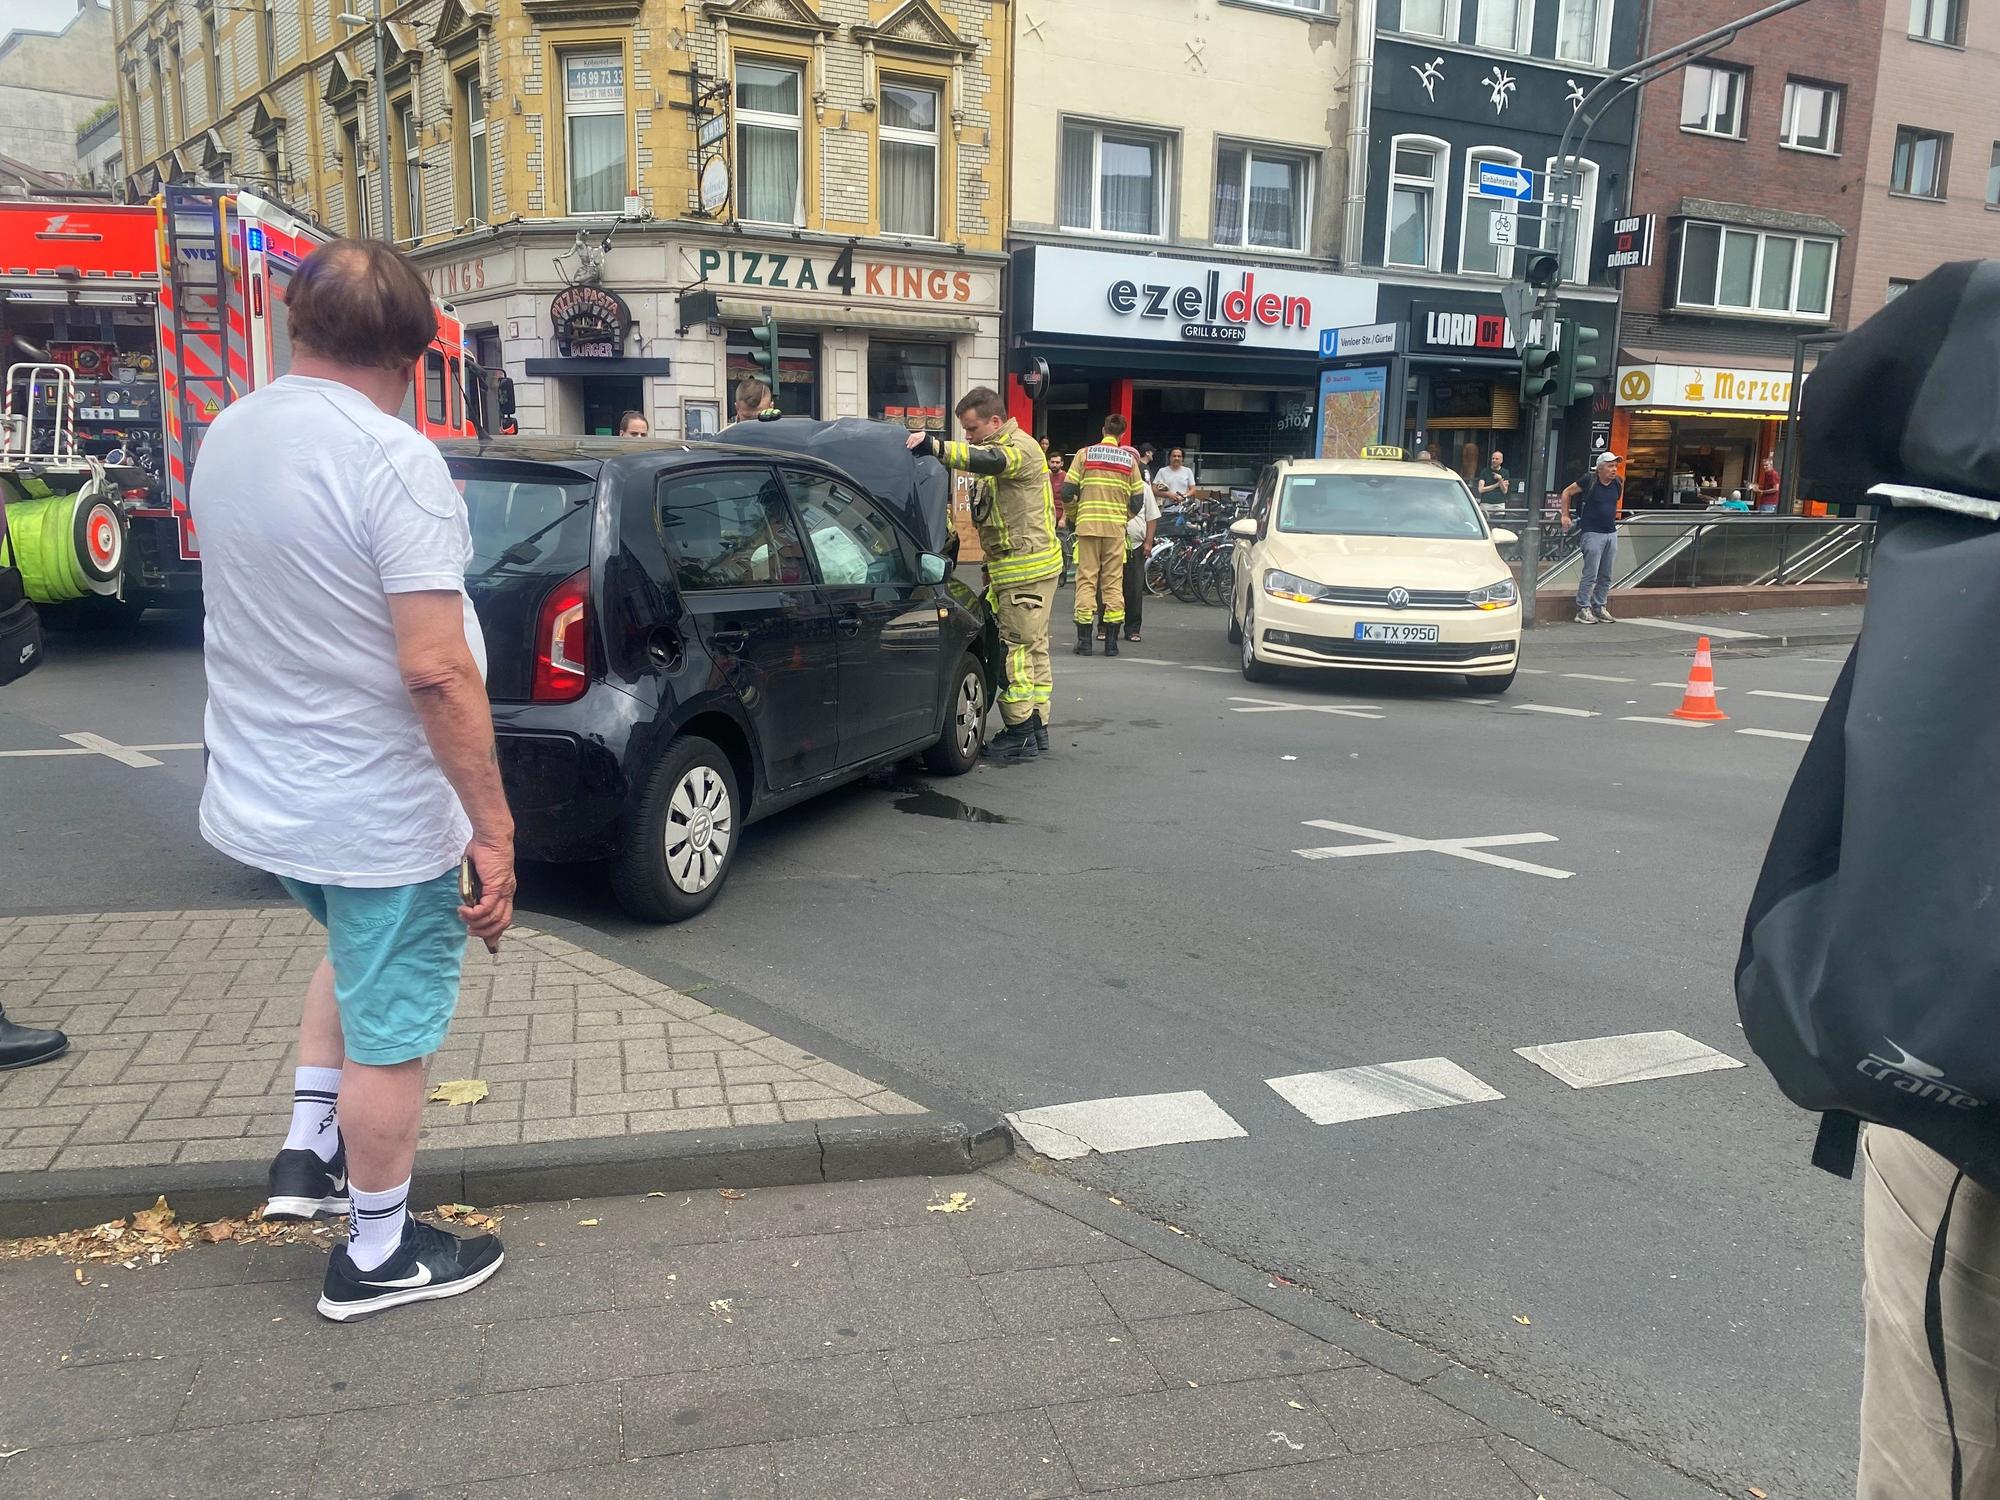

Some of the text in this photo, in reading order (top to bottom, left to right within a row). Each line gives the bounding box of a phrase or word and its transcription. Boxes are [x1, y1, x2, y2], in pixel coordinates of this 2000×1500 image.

[577, 70, 623, 86] 16 99 73 33
[1614, 217, 1640, 234] LORD
[1607, 250, 1640, 268] DÖNER
[700, 246, 971, 301] PIZZA 4 KINGS
[1107, 269, 1312, 330] ezelden
[1185, 326, 1245, 339] GRILL & OFEN
[1426, 311, 1562, 352] LORD OF DNR
[570, 342, 613, 357] BURGER
[1323, 332, 1335, 354] U
[1341, 337, 1361, 347] Venloer
[1369, 447, 1396, 456] TAXI
[1363, 625, 1436, 640] K TX 9950
[1856, 1058, 1980, 1110] crane
